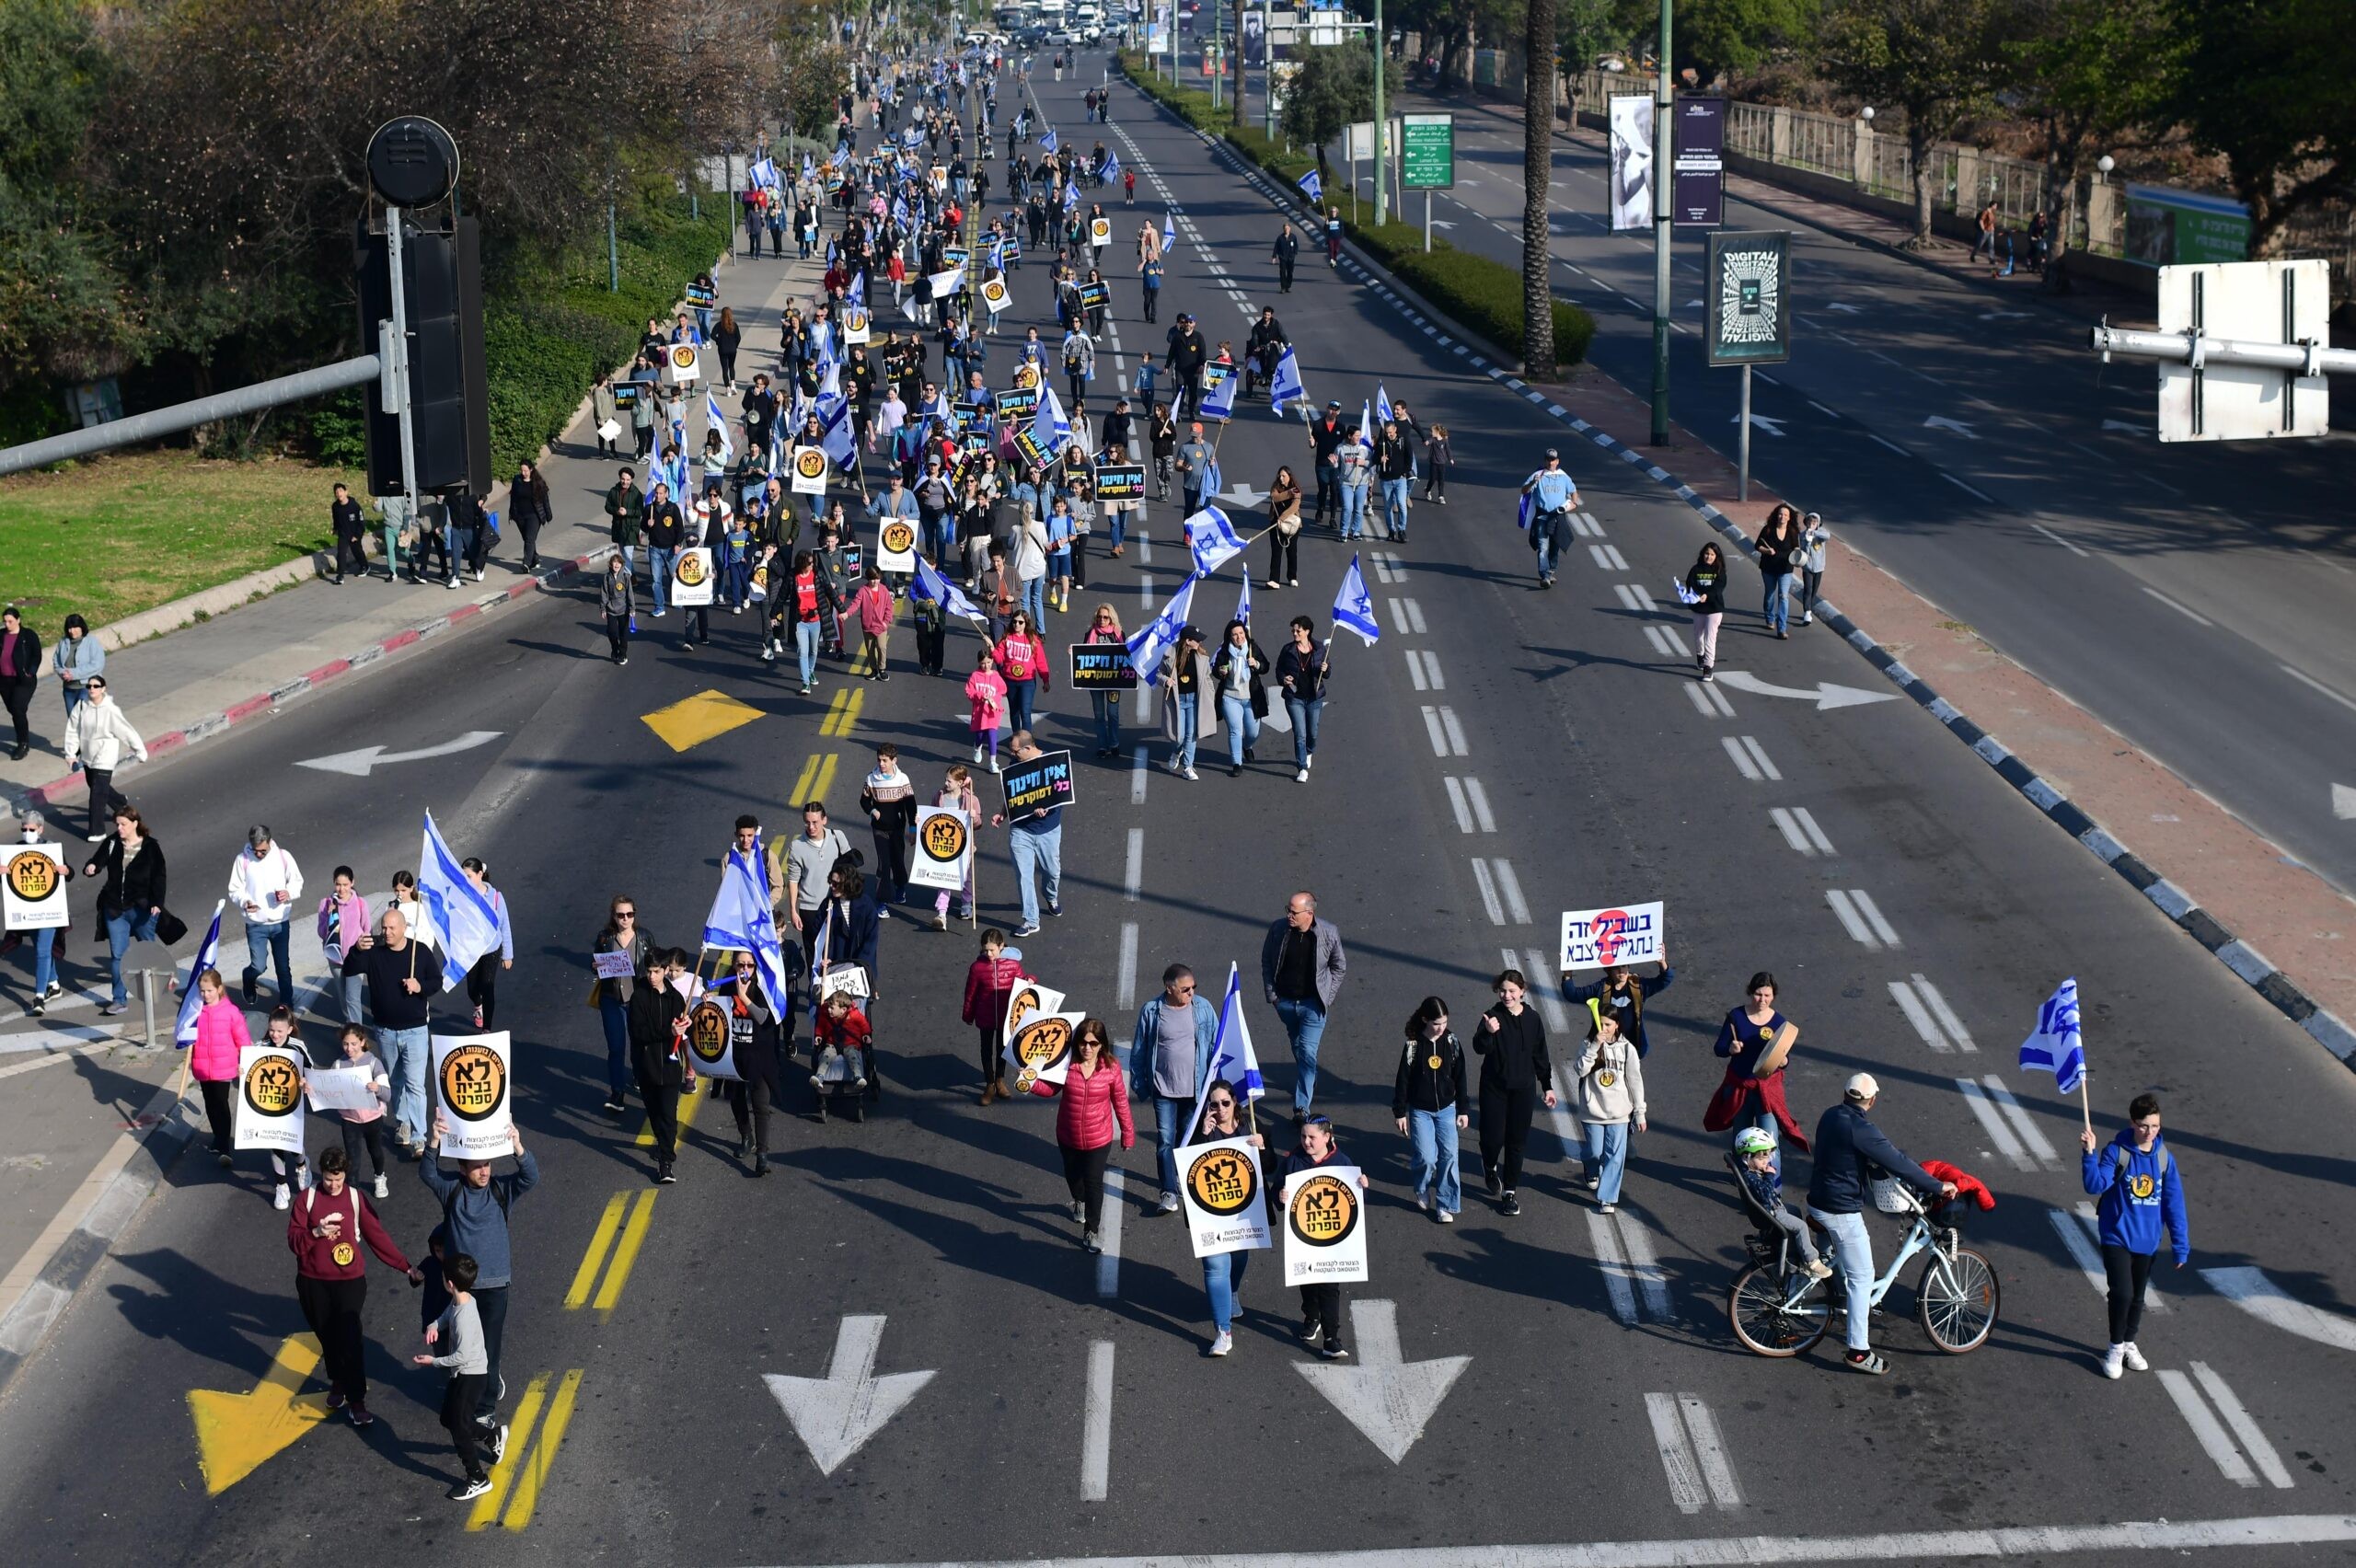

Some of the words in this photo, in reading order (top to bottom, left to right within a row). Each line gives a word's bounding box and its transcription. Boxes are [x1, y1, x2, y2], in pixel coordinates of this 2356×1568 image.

[1725, 251, 1774, 261] DIGITAL
[616, 388, 635, 398] חינוך
[1000, 397, 1022, 409] חינוך
[1022, 396, 1035, 405] אין
[804, 455, 818, 465] לא
[1100, 475, 1124, 487] חינוך
[1126, 474, 1142, 485] אין
[1098, 486, 1131, 494] דמוקרטיה
[1133, 484, 1143, 492] בלי
[891, 528, 907, 537] לא
[683, 558, 699, 569] לא
[1077, 655, 1110, 670] חינוך
[1114, 655, 1133, 670] אין
[1075, 670, 1119, 680] דמוקרטיה
[1121, 669, 1136, 678] בלי
[1045, 764, 1067, 786] אין
[1007, 770, 1040, 797] חינוך
[1054, 780, 1069, 791] בלי
[1009, 786, 1052, 809] דמוקרטיה
[933, 823, 955, 837] לא
[20, 859, 44, 875] לא
[1569, 922, 1590, 939] זה
[1597, 914, 1651, 936] בשביל
[1566, 940, 1603, 963] לצבא
[698, 1012, 718, 1031] לא
[1033, 1027, 1062, 1043] לא
[260, 1066, 291, 1085] לא
[455, 1058, 490, 1081] לא
[1210, 1148, 1233, 1157] גזענות
[1203, 1159, 1238, 1182] לא
[1207, 1178, 1242, 1193] בבית
[1315, 1177, 1336, 1185] גזענות
[1209, 1189, 1243, 1203] ספרנו
[1305, 1188, 1338, 1211] לא
[1306, 1209, 1340, 1222] בבית
[1307, 1221, 1341, 1232] ספרנו
